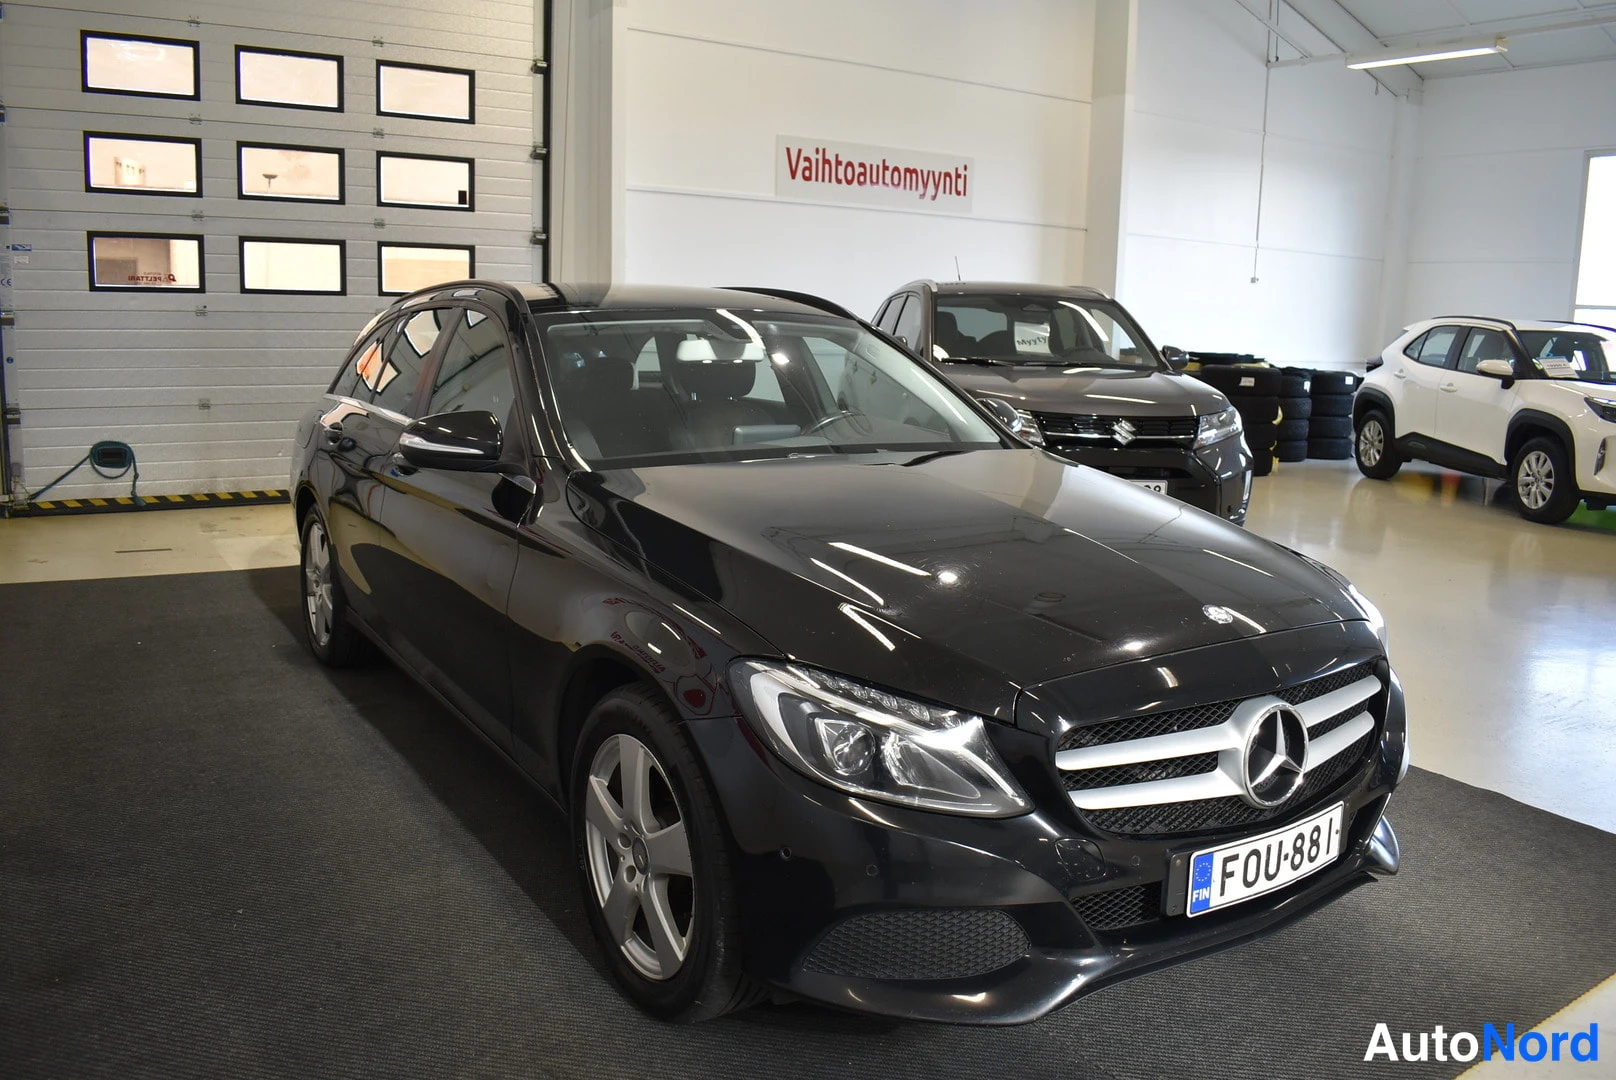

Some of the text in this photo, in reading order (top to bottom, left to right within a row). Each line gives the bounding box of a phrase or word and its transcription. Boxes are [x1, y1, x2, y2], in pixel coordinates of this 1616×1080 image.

[785, 147, 968, 201] Vaihtoautomyynti
[1016, 336, 1047, 346] Myyty
[1219, 817, 1333, 897] FOU-881
[1192, 886, 1211, 903] FIN
